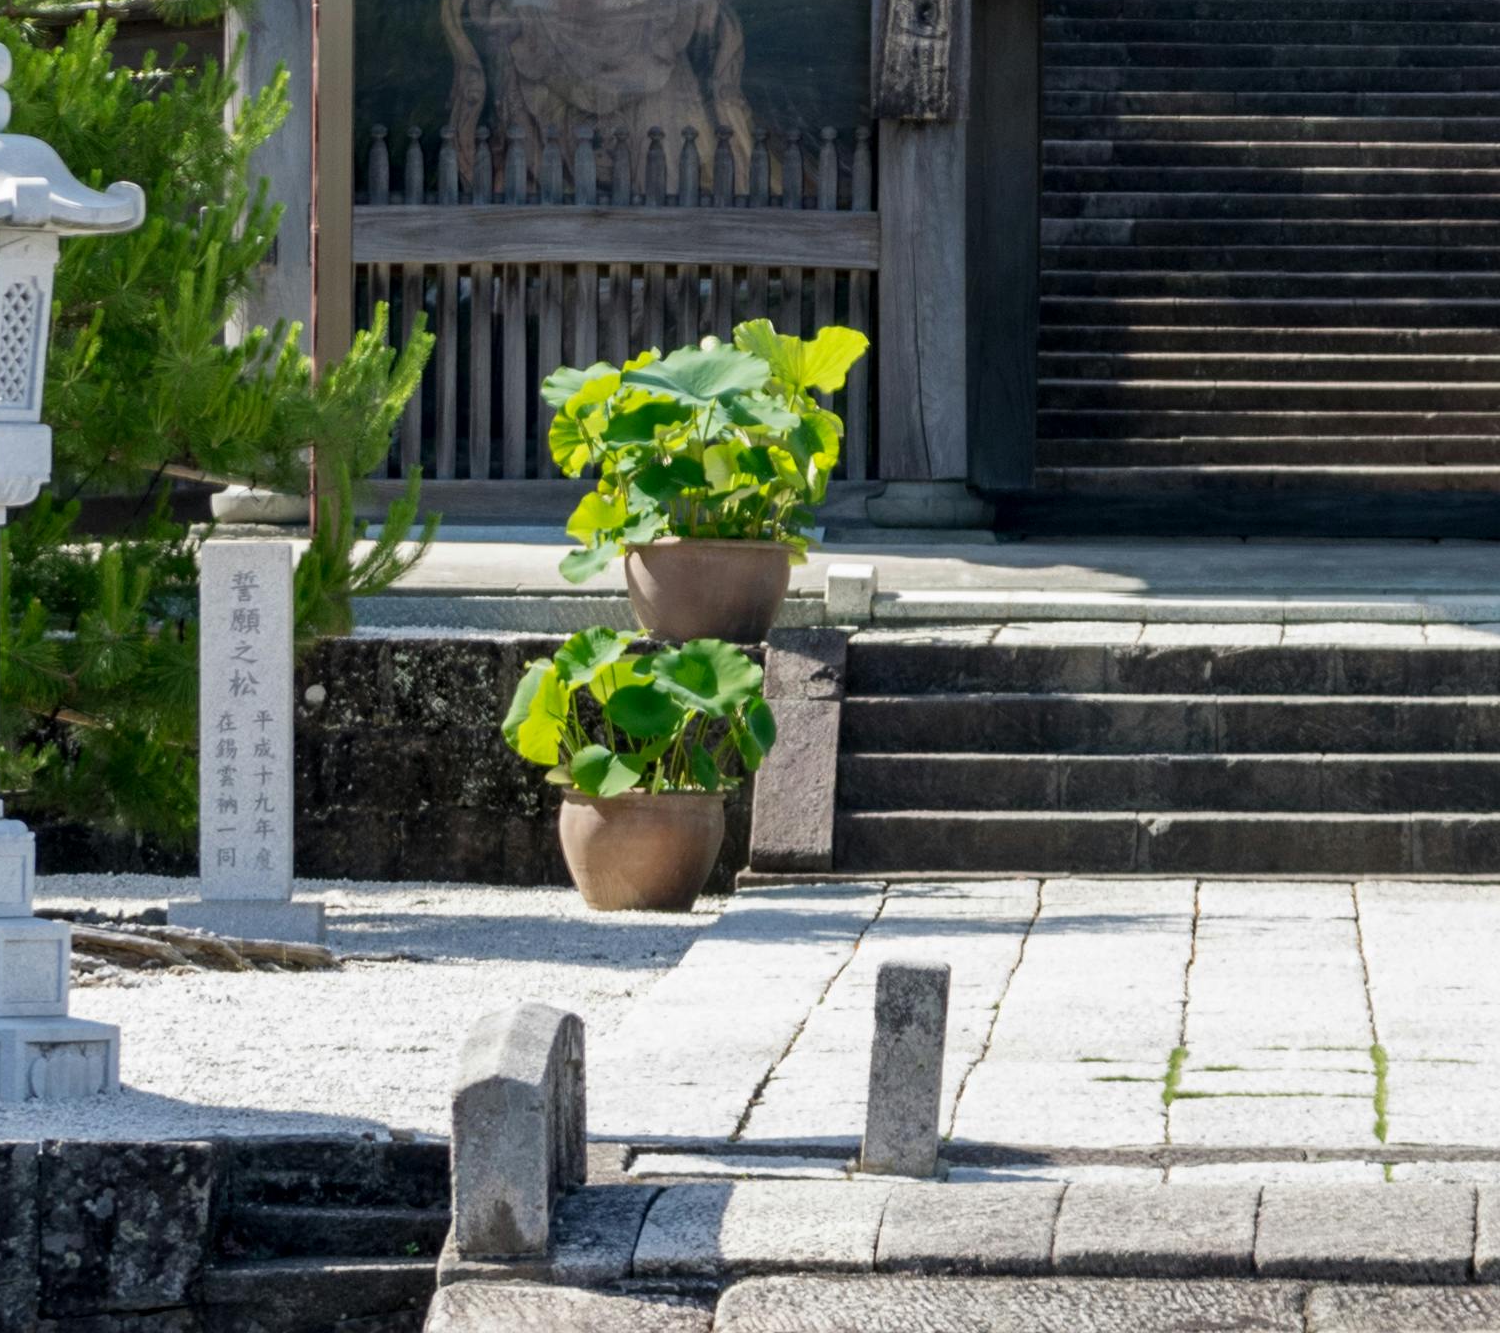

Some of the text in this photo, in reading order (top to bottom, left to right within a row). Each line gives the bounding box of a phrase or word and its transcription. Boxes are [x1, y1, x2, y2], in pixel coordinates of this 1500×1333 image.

[228, 570, 261, 698] 誓願之松
[252, 710, 276, 871] 平成十九年度
